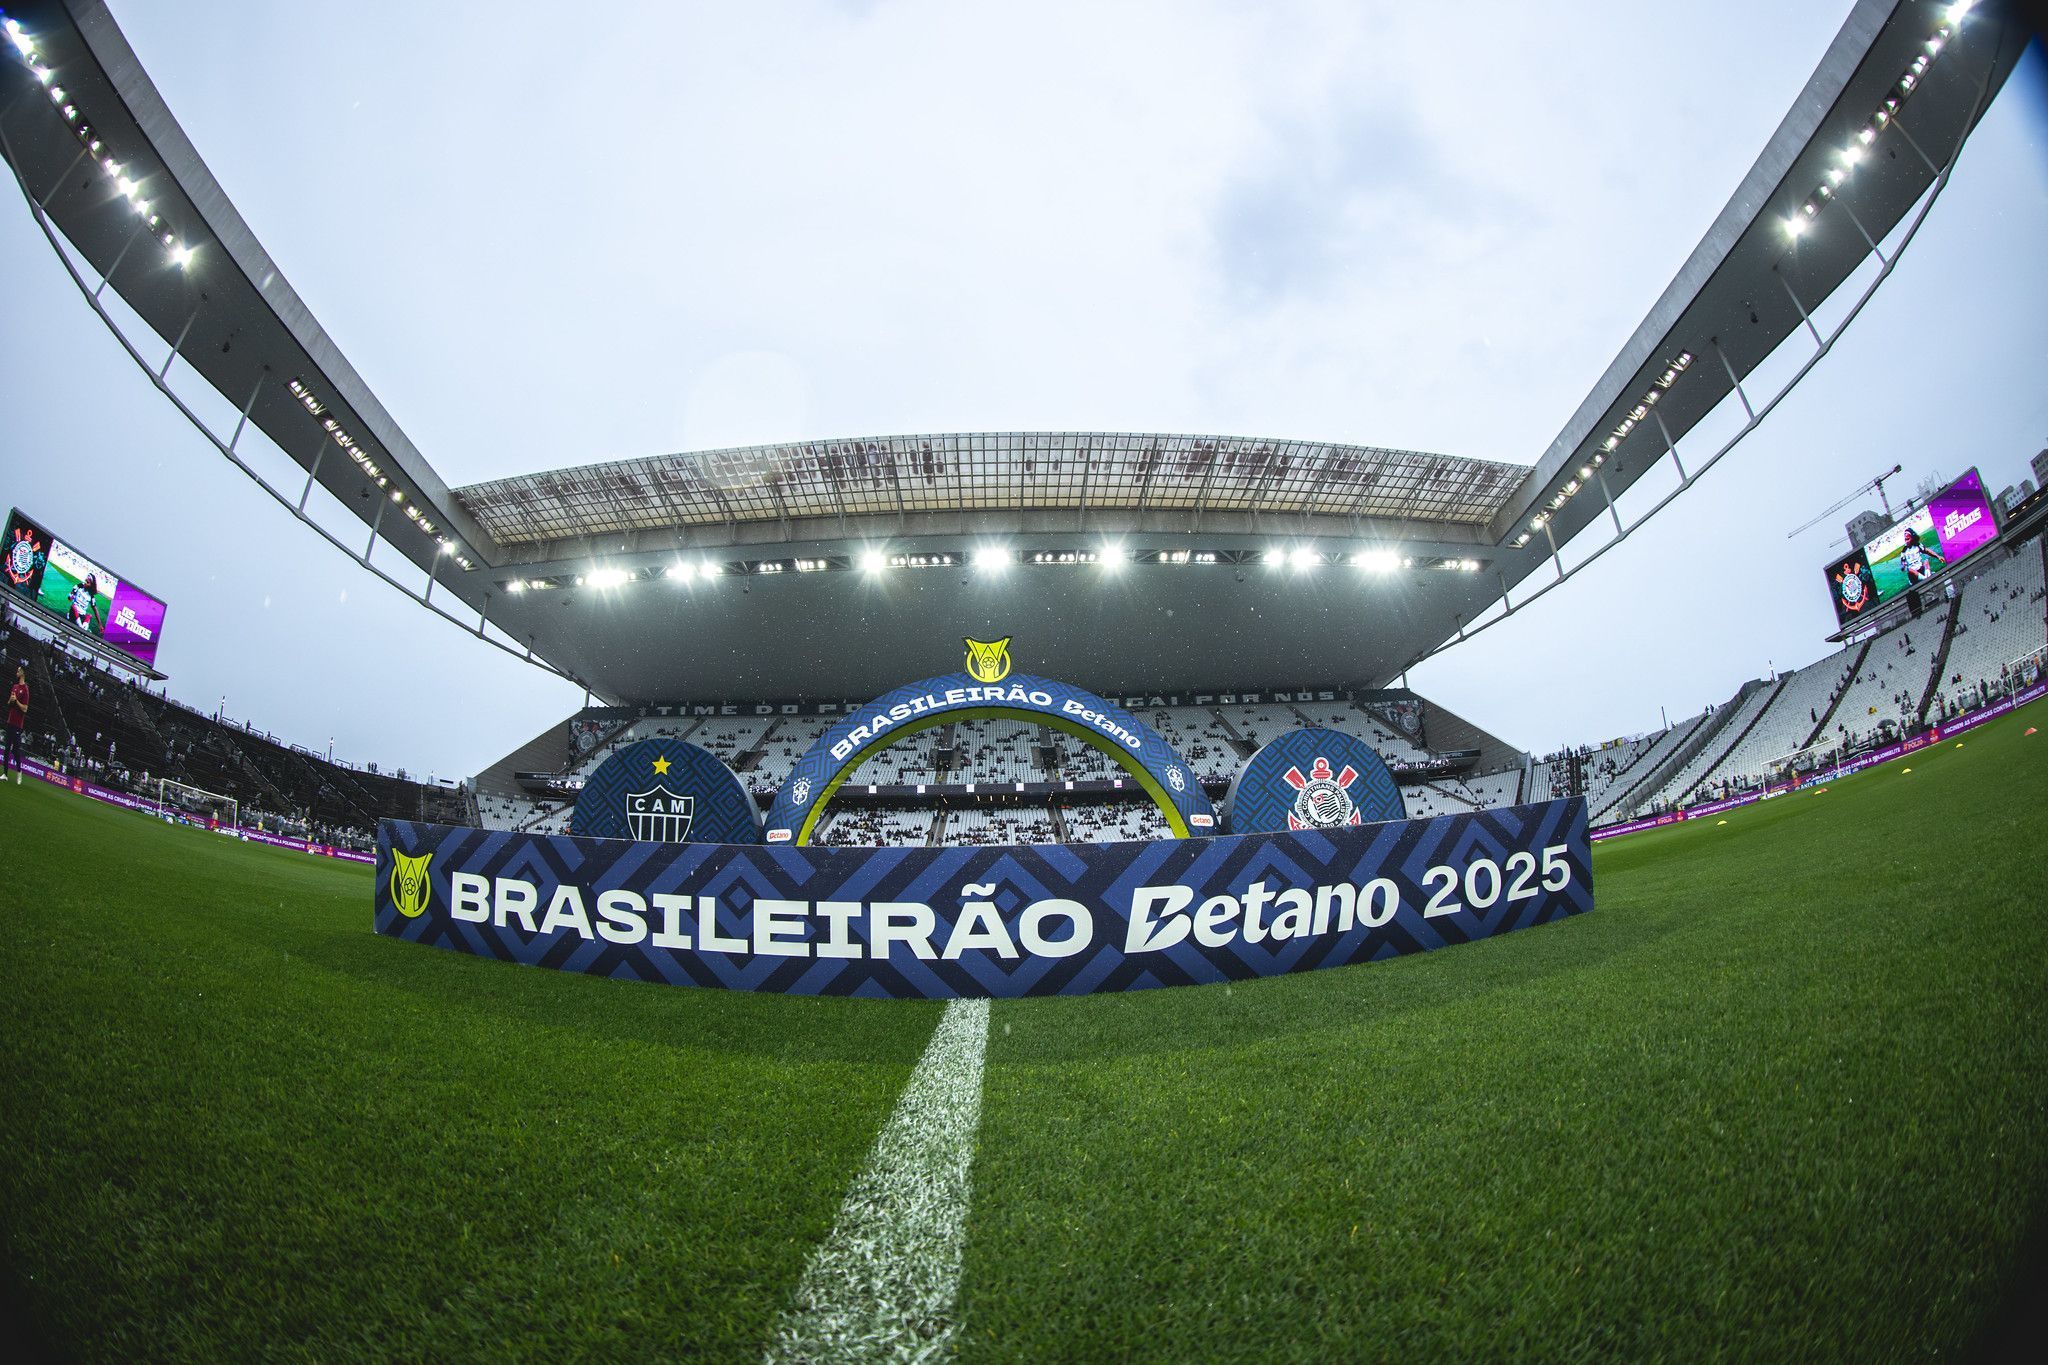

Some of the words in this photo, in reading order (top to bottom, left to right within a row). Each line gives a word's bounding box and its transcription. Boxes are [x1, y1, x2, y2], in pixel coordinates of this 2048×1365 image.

[656, 706, 737, 715] TIME
[756, 704, 799, 714] DO
[1196, 693, 1260, 705] POR
[829, 683, 1053, 761] BRASILEIRÃO
[1062, 699, 1141, 748] Betano
[635, 798, 685, 814] CAM
[1302, 784, 1335, 810] CORINTHIANS
[451, 871, 1094, 960] BRASILEIRÃO
[1124, 877, 1400, 954] Betano
[1421, 844, 1572, 919] 2025
